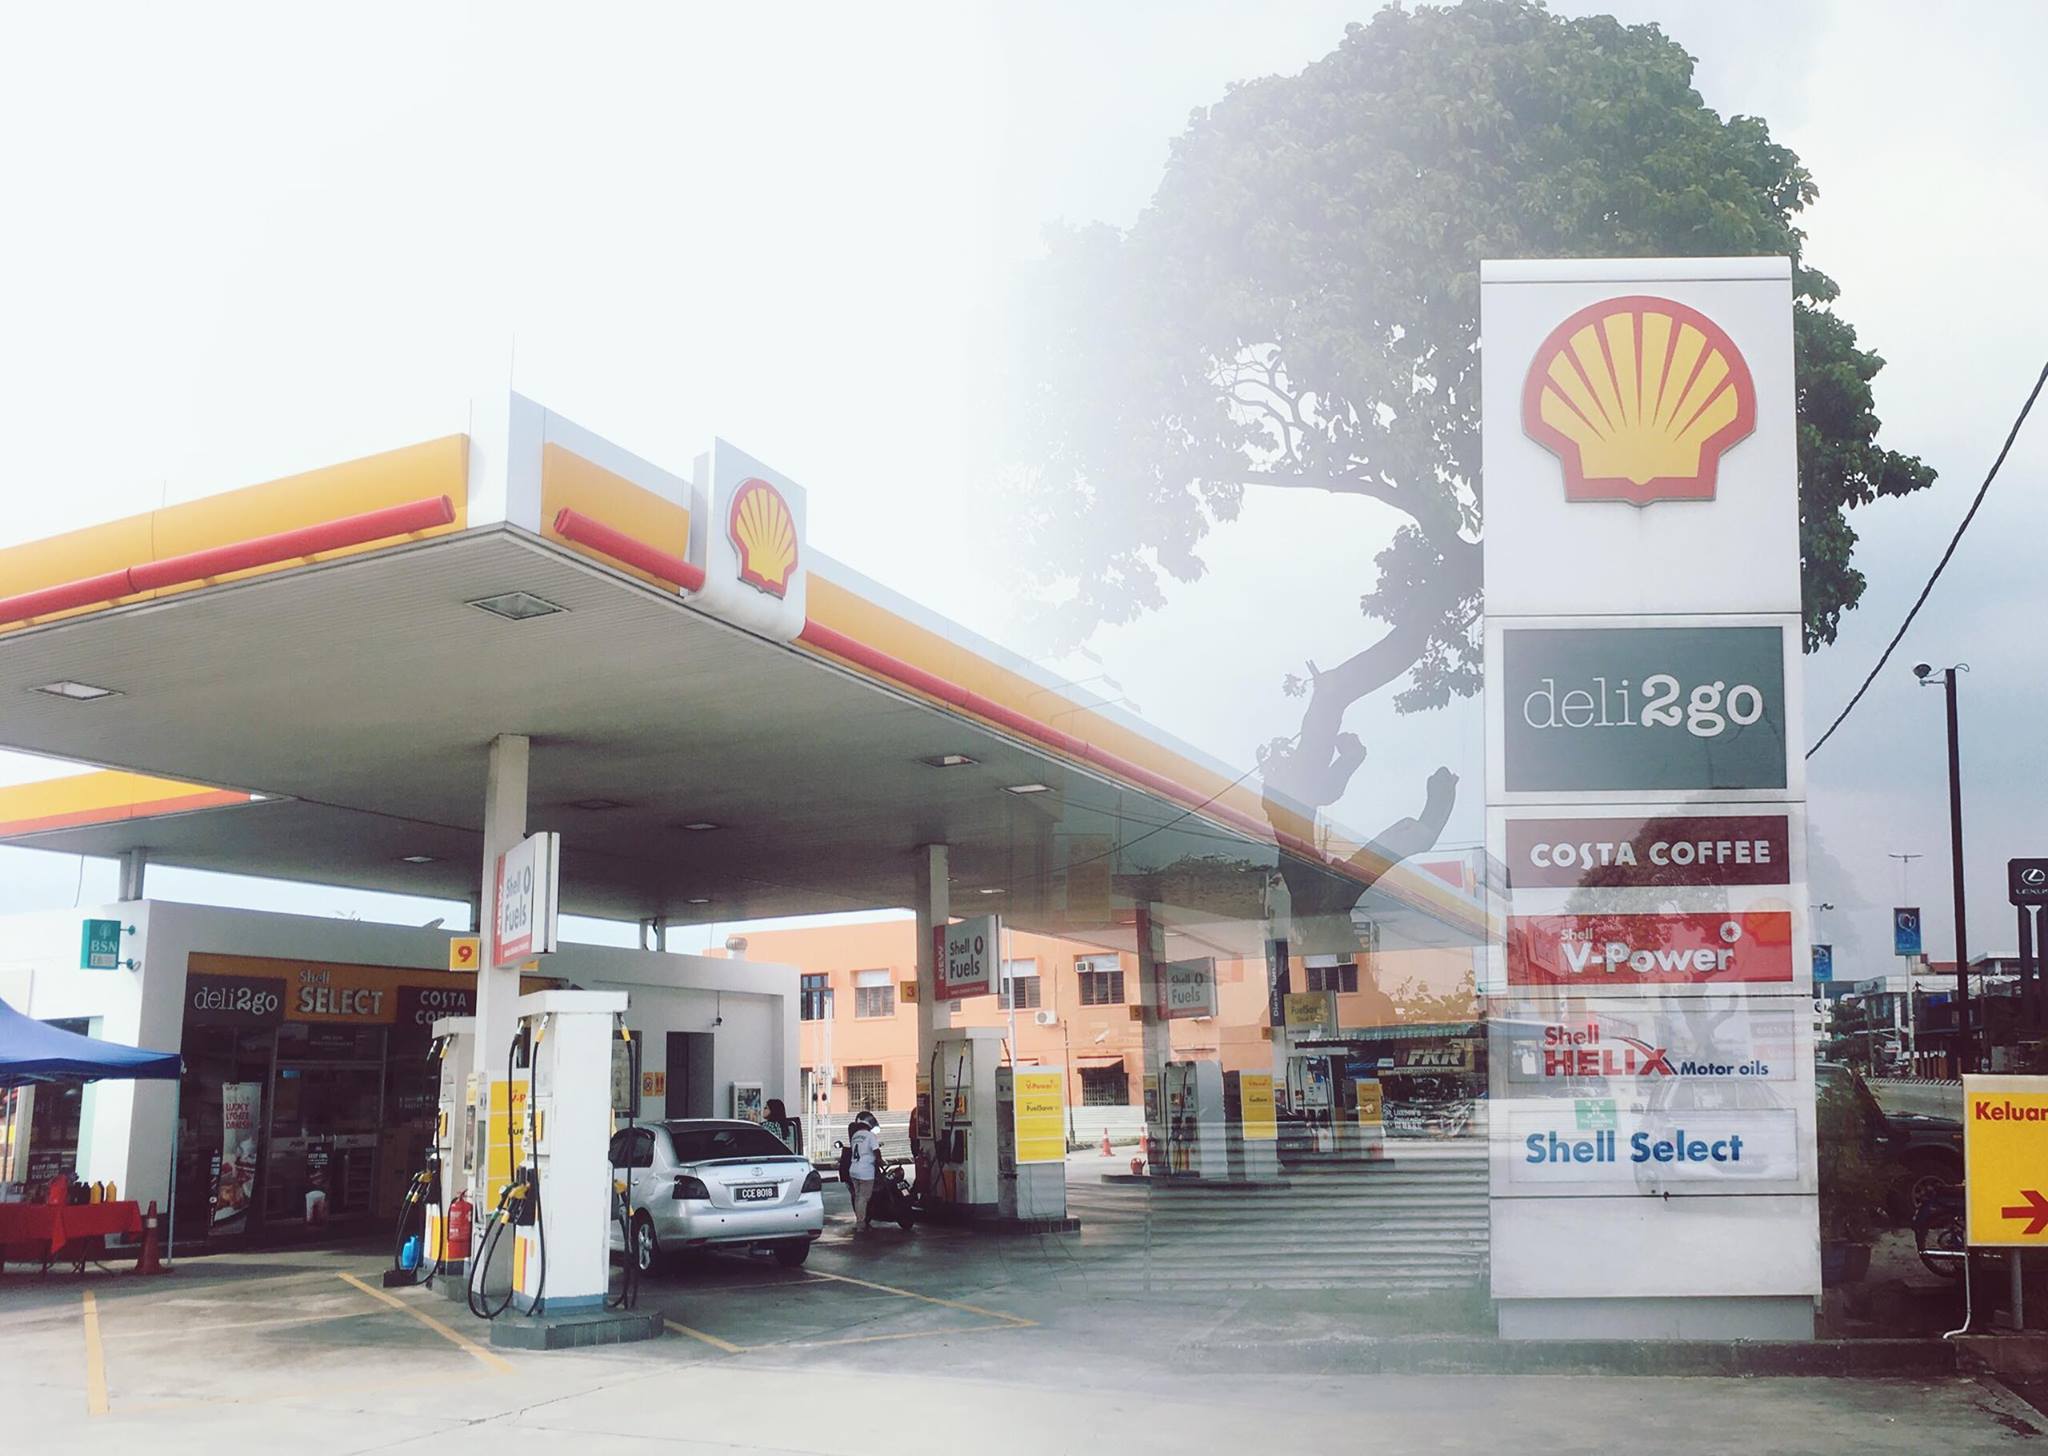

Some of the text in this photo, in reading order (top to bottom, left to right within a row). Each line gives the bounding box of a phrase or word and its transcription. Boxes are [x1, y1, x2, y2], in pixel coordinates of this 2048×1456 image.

[1523, 674, 1763, 737] deli2go
[1530, 840, 1771, 869] COSTA COFFEE
[506, 871, 521, 897] Shell
[504, 896, 527, 932] Fuels
[1560, 928, 1593, 941] Shell
[91, 940, 117, 953] BSN
[458, 945, 472, 962] 9
[950, 938, 970, 956] Shell
[950, 954, 980, 979] Fuels
[1561, 942, 1734, 973] V-Power
[300, 969, 330, 983] Shell
[194, 987, 278, 1015] deli2go
[300, 987, 384, 1014] SELECT
[420, 990, 466, 1007] COSTA
[1172, 986, 1200, 1004] Fuels
[415, 1010, 469, 1024] COF
[1544, 1024, 1598, 1045] Shell
[1544, 1049, 1769, 1076] HELIX Motor oils
[1975, 1101, 2048, 1121] Keluar
[1526, 1130, 1743, 1163] Shell Select
[742, 1186, 773, 1199] CCE 8018
